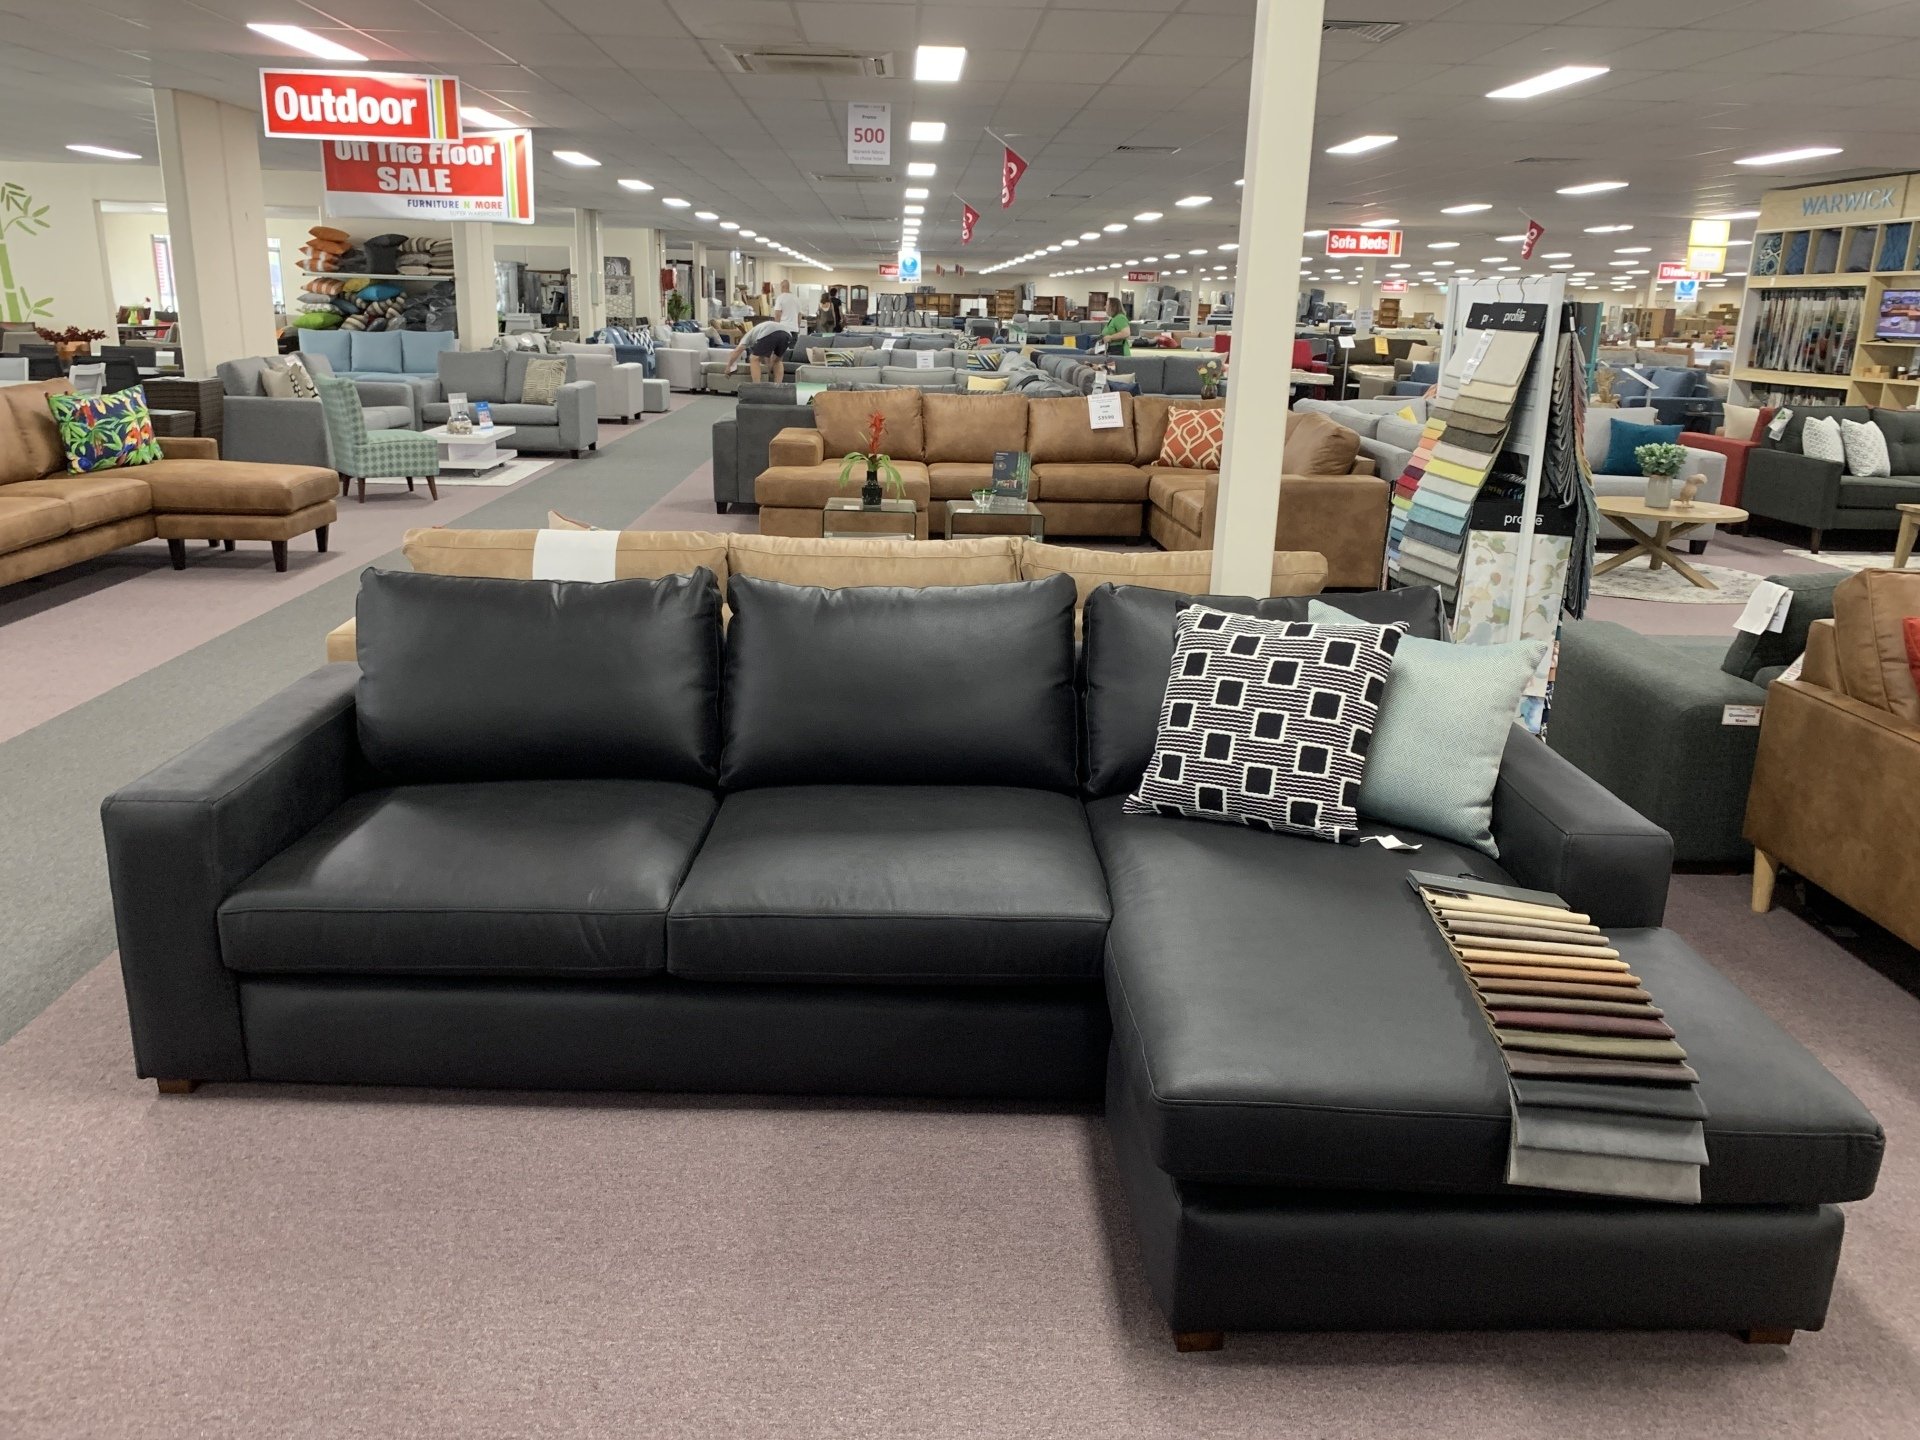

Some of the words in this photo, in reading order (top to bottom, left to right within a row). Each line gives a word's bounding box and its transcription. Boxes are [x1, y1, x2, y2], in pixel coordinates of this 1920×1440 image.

[274, 85, 417, 125] Outdoor
[853, 127, 885, 144] 500
[377, 141, 423, 164] The
[428, 143, 496, 166] Floor
[376, 166, 453, 193] SALE
[407, 199, 460, 209] FURNITURE
[463, 200, 471, 209] N
[475, 201, 503, 210] MORE
[1802, 187, 1897, 216] WARWICK
[1331, 234, 1357, 249] Sofa
[1360, 235, 1388, 250] Beds
[1502, 308, 1527, 324] profile
[1504, 514, 1544, 526] proe
